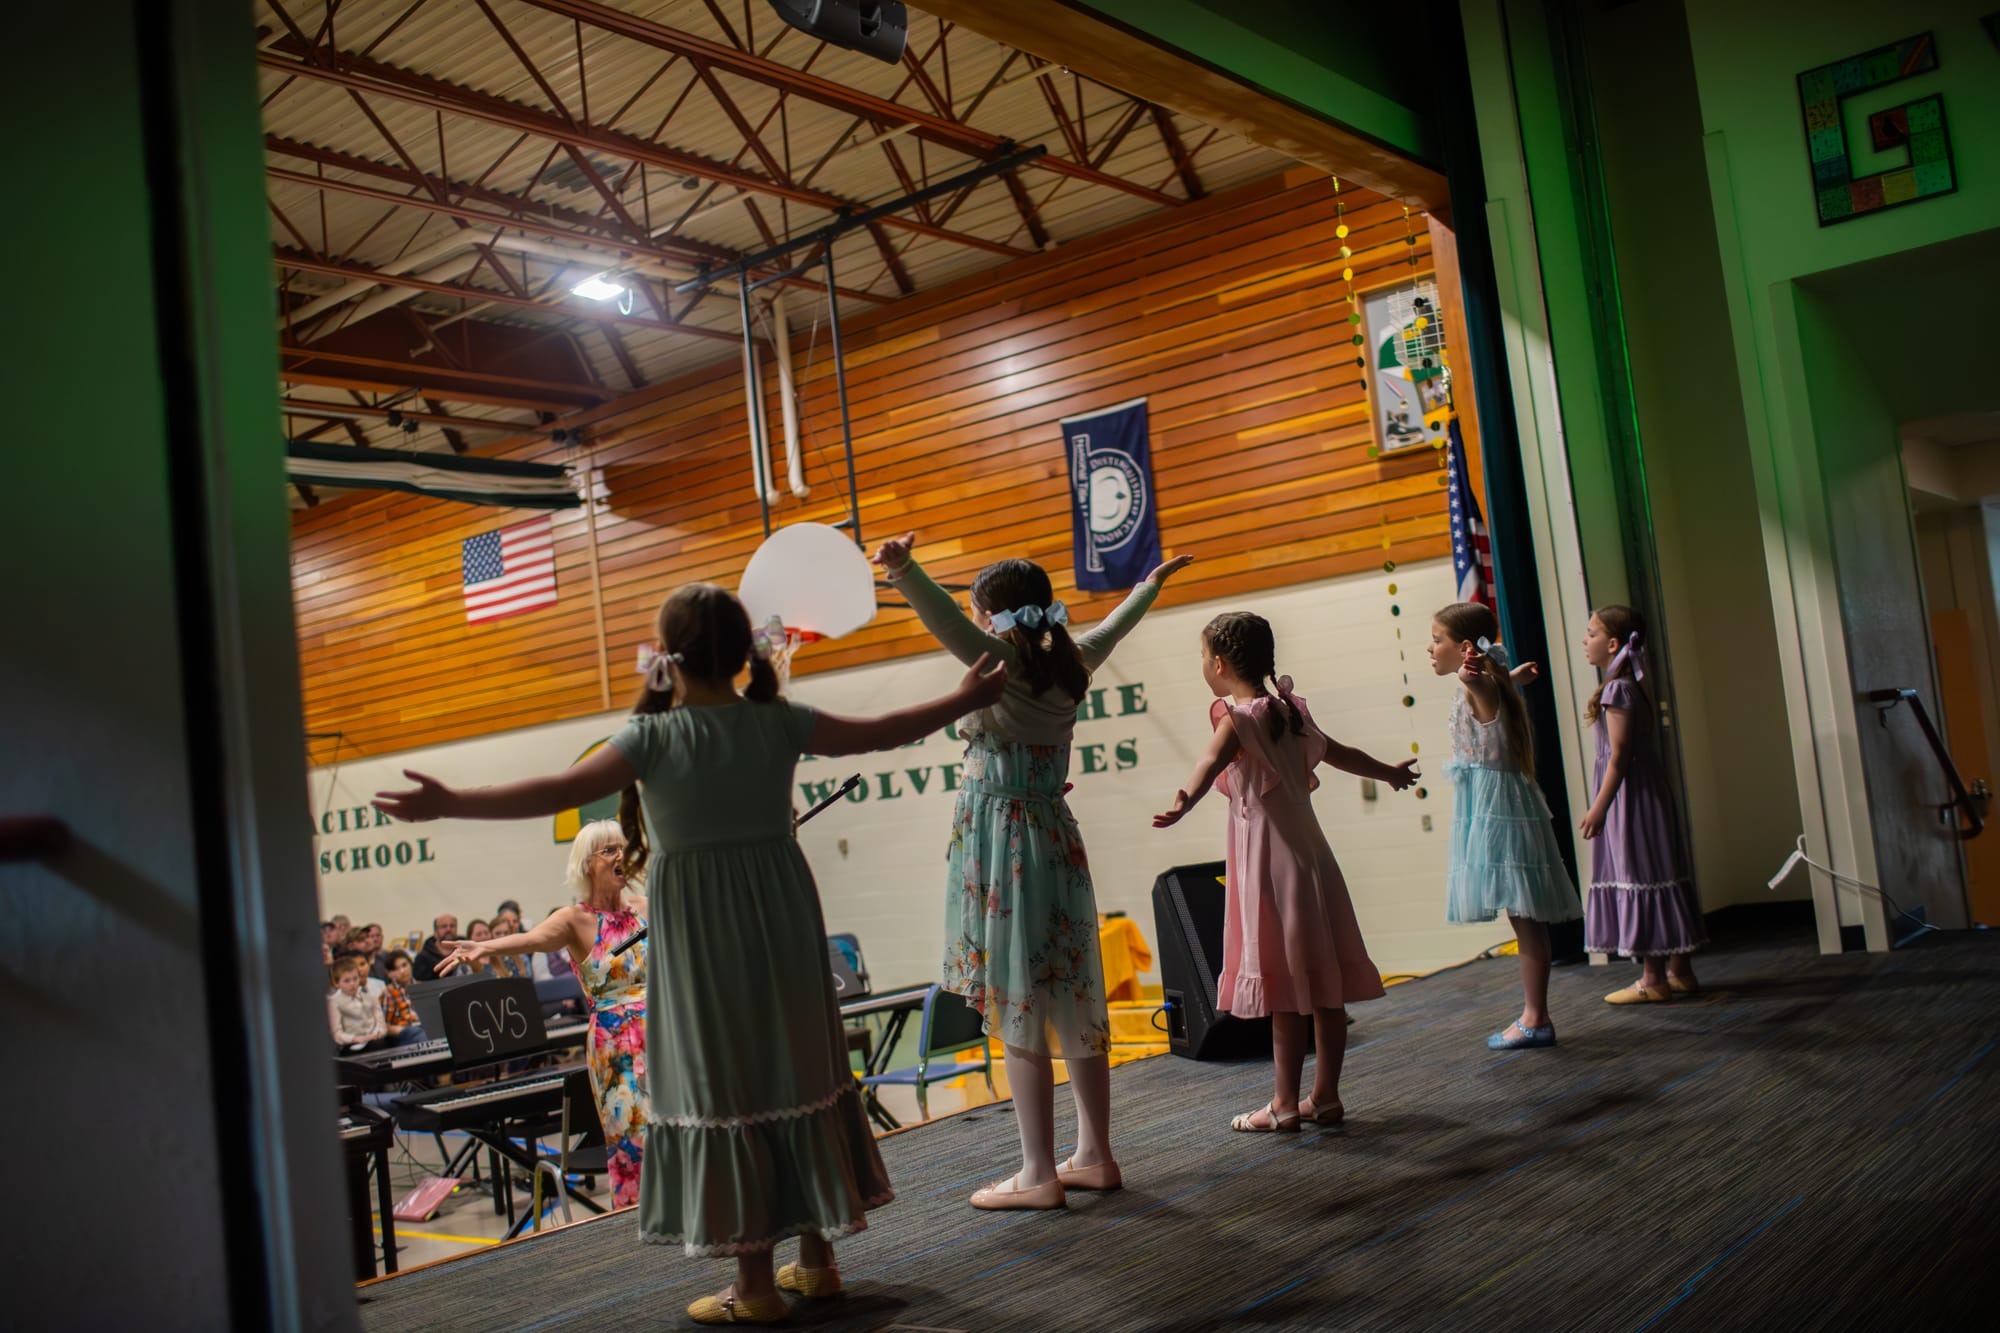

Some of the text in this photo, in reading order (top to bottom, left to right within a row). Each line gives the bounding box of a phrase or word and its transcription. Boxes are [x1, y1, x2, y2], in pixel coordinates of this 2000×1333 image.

[1075, 682, 1149, 722] HE
[798, 738, 1139, 808] WOLVEES
[319, 838, 436, 875] SCHOOL
[467, 996, 528, 1053] GVS
